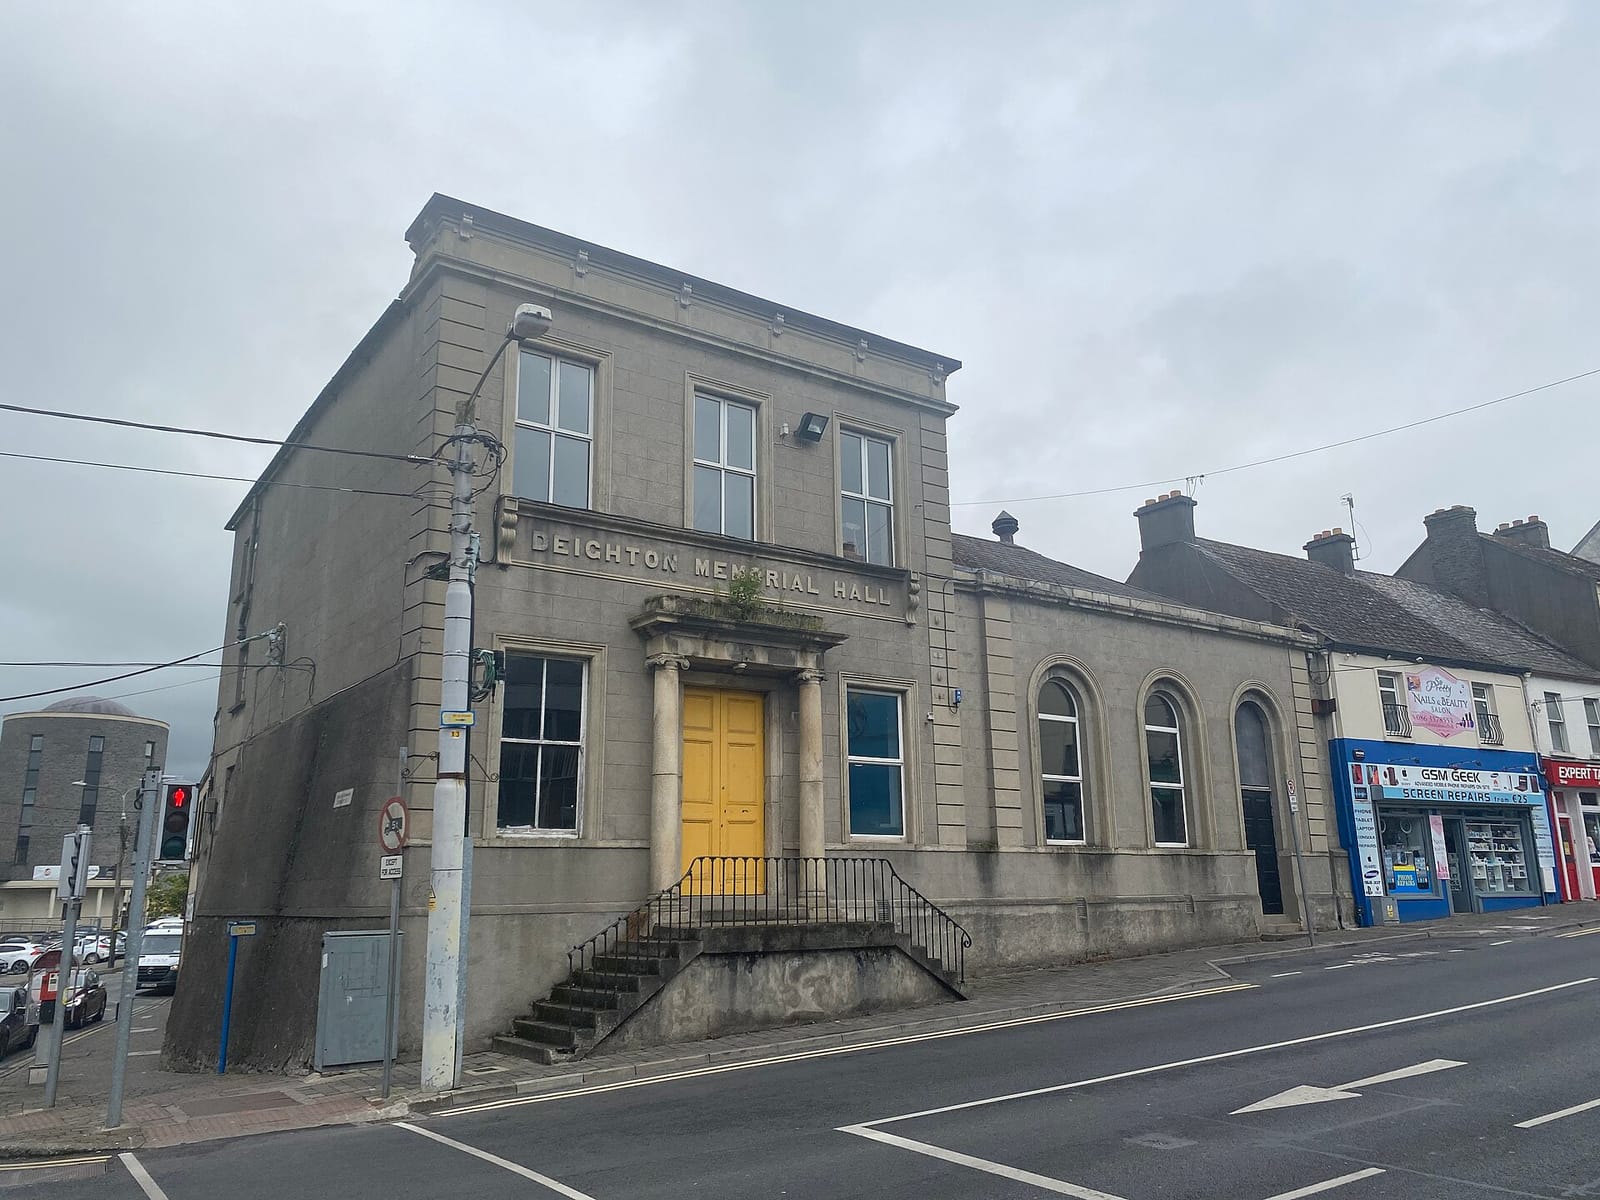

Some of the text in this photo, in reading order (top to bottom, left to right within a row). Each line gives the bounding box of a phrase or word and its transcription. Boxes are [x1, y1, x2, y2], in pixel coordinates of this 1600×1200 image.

[532, 530, 678, 573] DEIGHTON
[834, 580, 891, 606] HALL
[1440, 697, 1468, 709] BEAUTY
[1421, 769, 1481, 783] GSM GEEK
[1558, 766, 1591, 780] EXPERT
[1403, 788, 1444, 799] SCREEN
[1448, 791, 1491, 802] REPAIRS
